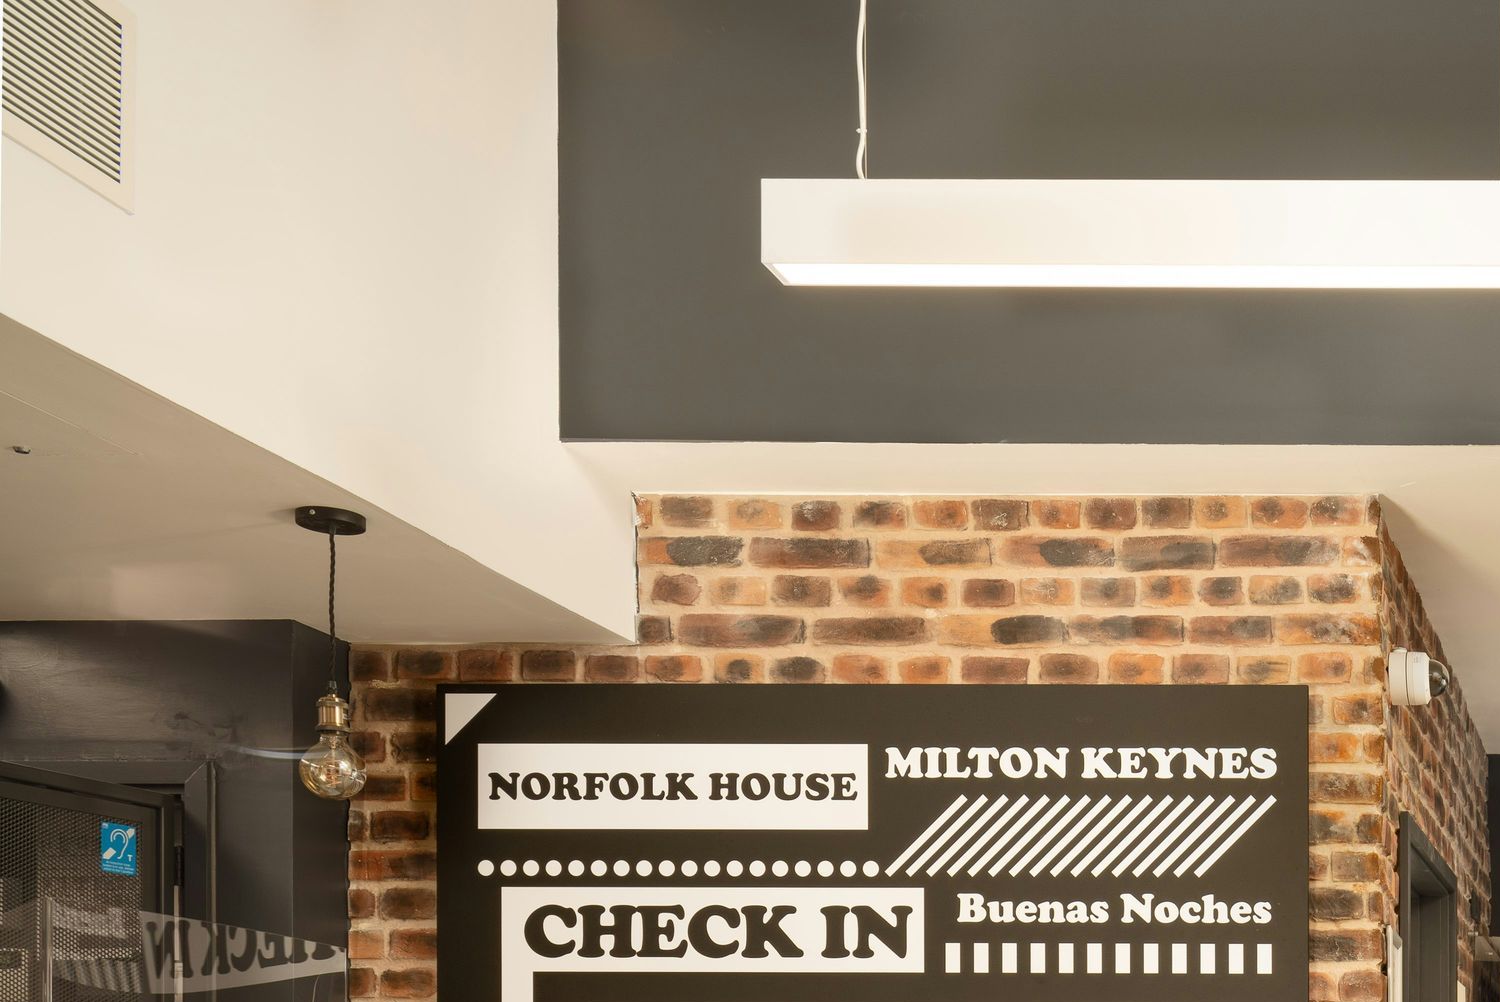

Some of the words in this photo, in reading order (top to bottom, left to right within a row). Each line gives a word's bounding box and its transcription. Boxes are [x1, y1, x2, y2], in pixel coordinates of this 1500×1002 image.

[885, 746, 1070, 779] MILTON
[1080, 746, 1278, 780] KEYNES
[488, 772, 699, 801] NORFOLK
[708, 772, 858, 801] HOUSE
[956, 892, 1110, 924] Buenas
[1119, 892, 1273, 925] Noches
[523, 904, 804, 959] CHECK
[821, 905, 913, 959] IN
